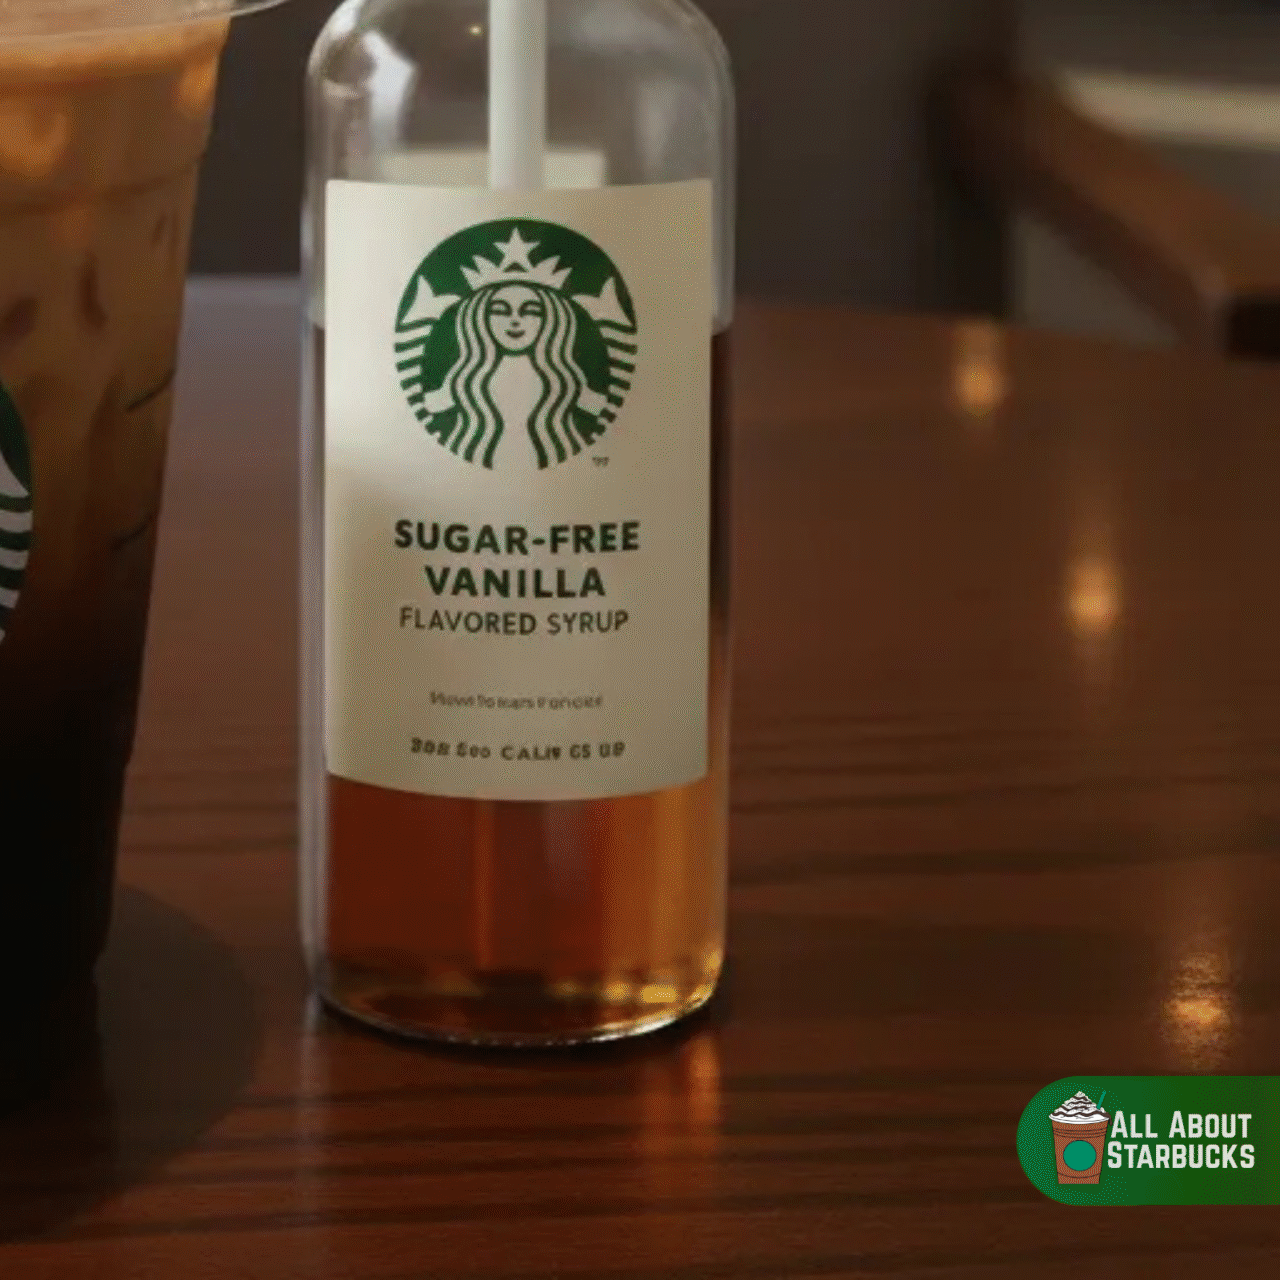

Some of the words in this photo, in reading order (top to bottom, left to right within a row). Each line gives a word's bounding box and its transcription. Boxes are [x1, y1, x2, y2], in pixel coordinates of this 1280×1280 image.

[394, 519, 640, 556] SUGAR-FREE
[424, 564, 606, 599] VANILLA
[399, 606, 537, 636] FLAVORED
[546, 609, 630, 636] SYRUP
